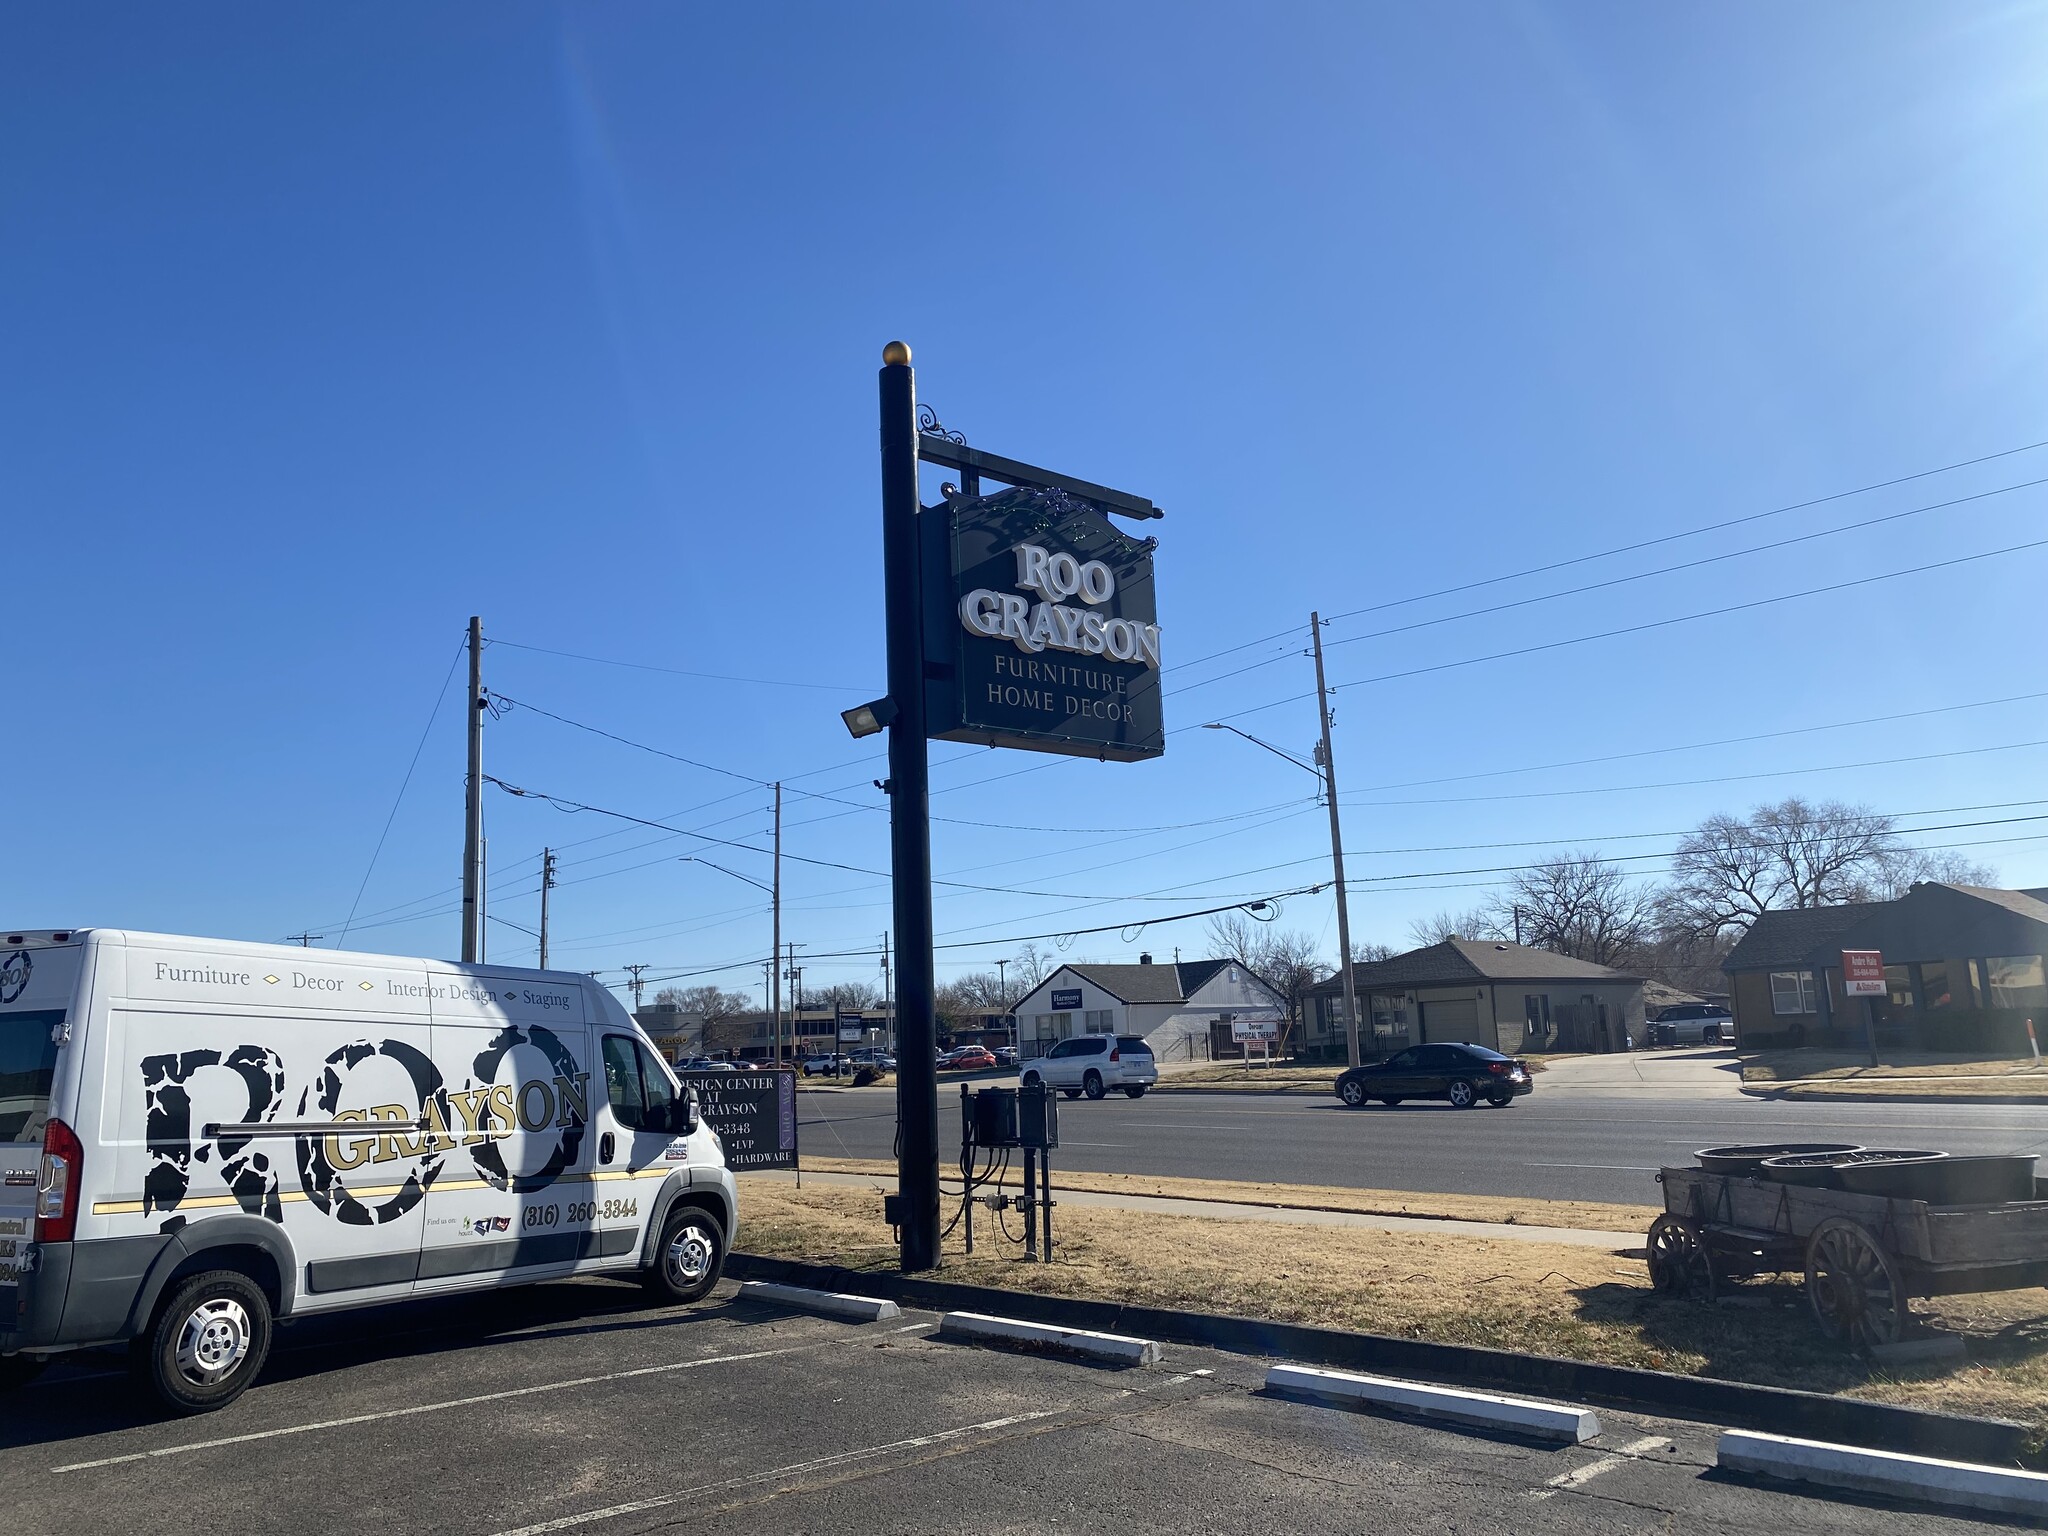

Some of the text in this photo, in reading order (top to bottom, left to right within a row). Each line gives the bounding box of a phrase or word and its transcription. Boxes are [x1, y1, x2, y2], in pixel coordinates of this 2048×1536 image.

[1012, 543, 1115, 604] ROO
[958, 588, 1162, 668] GRAYSON
[994, 654, 1126, 694] FURNITURE
[987, 683, 1136, 727] HOME DECOR
[155, 962, 570, 1010] Furniture Decor Interior Design Staging
[1053, 994, 1080, 1003] Harmony
[653, 1036, 688, 1044] FARGO
[1235, 1031, 1277, 1040] PHYSICAL THERAPY
[726, 1077, 774, 1090] CENTER
[704, 1091, 722, 1103] AT
[699, 1102, 759, 1116] GRAYSON
[324, 1072, 590, 1171] GRAYSON
[140, 1024, 586, 1235] ROO
[708, 1122, 751, 1135] 0-3348
[736, 1140, 754, 1150] LVP
[736, 1151, 792, 1164] HARDWARE
[5, 1168, 37, 1178] RAM
[521, 1203, 559, 1231] (316)
[566, 1197, 638, 1223] 260-3344
[426, 1218, 440, 1226] Find
